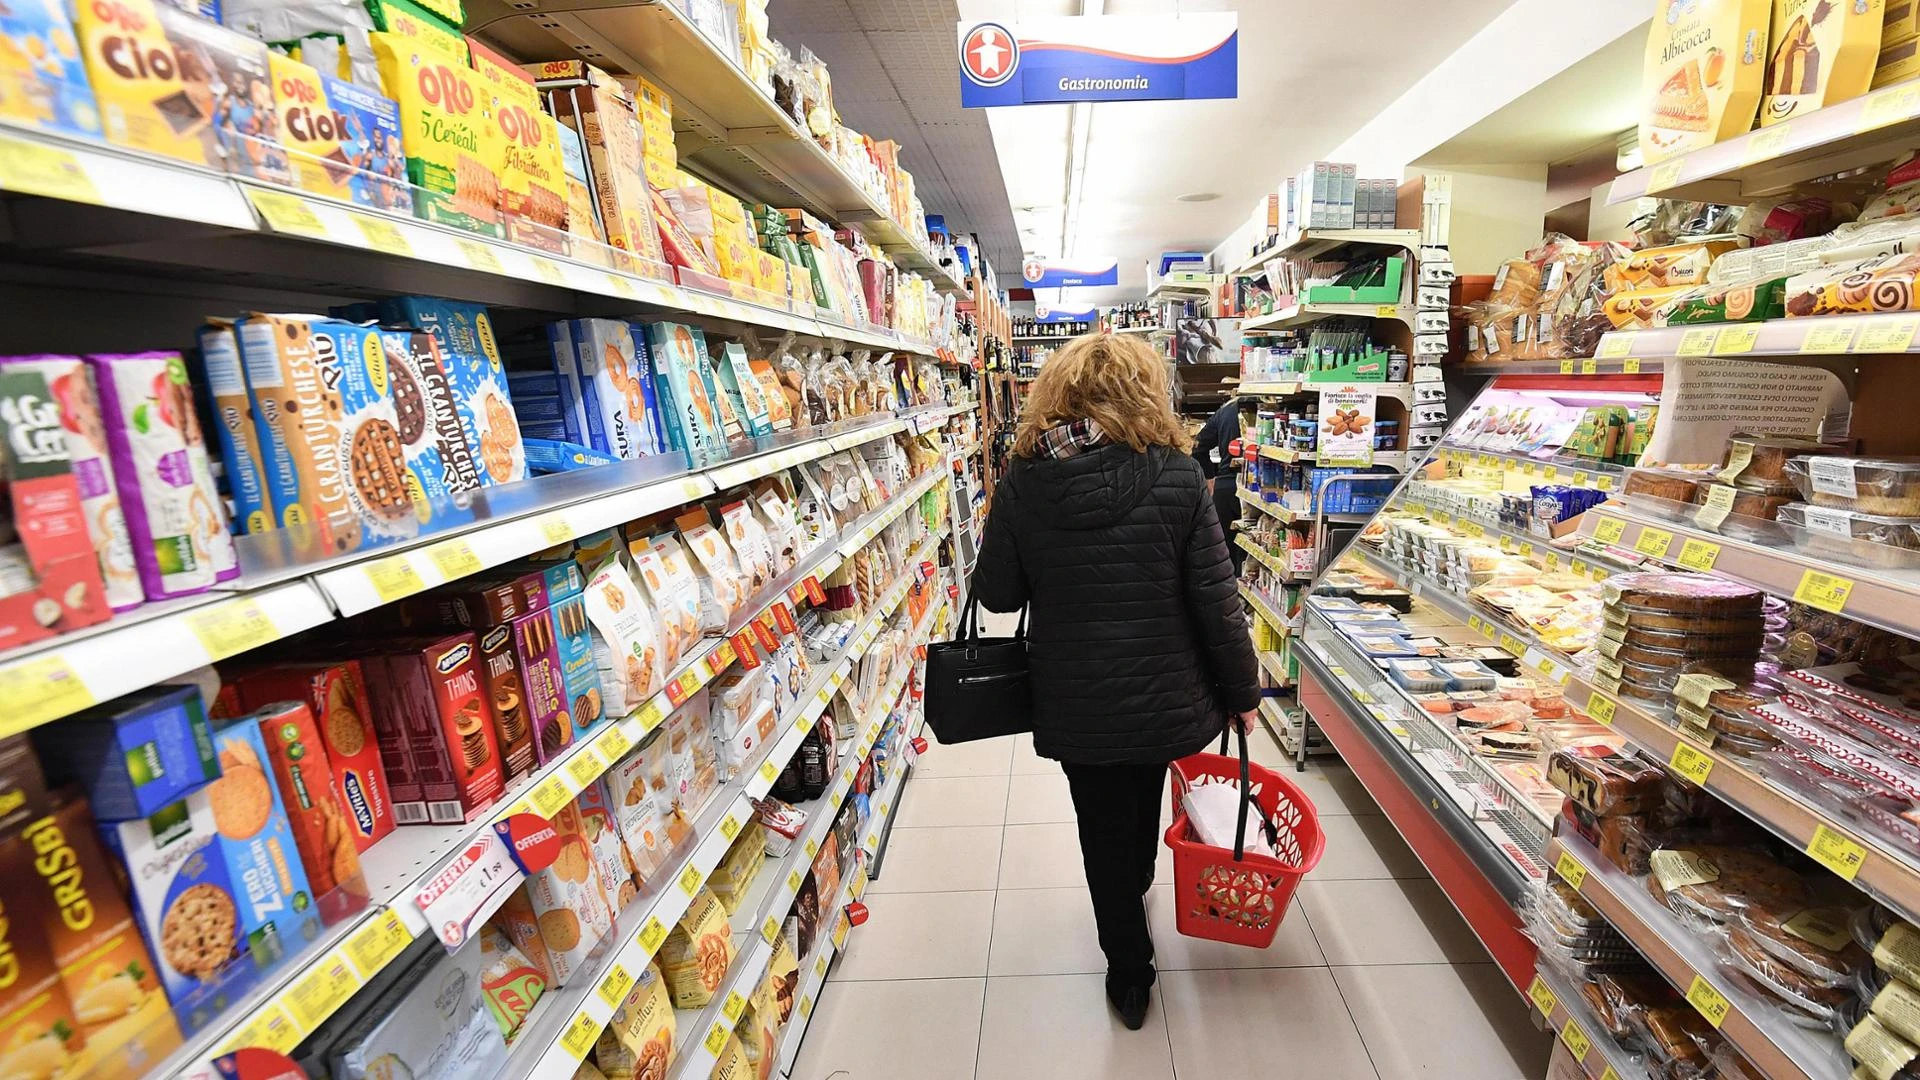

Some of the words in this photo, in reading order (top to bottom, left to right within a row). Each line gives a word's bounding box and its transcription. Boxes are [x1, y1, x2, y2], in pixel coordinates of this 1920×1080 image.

[1660, 26, 1712, 65] Albicocca
[281, 78, 317, 103] ORO
[418, 64, 475, 115] ORO
[1058, 75, 1149, 92] Gastronomia
[286, 106, 353, 142] Ciok
[432, 118, 478, 153] Cereali
[498, 105, 542, 149] ORO
[419, 352, 434, 371] IL
[287, 345, 345, 504] GRANTURCHESE
[613, 410, 630, 459] SURA
[487, 649, 515, 679] THINS
[444, 669, 478, 703] THINS
[515, 828, 557, 852] OFFERTA
[417, 852, 476, 906] OFFERTA
